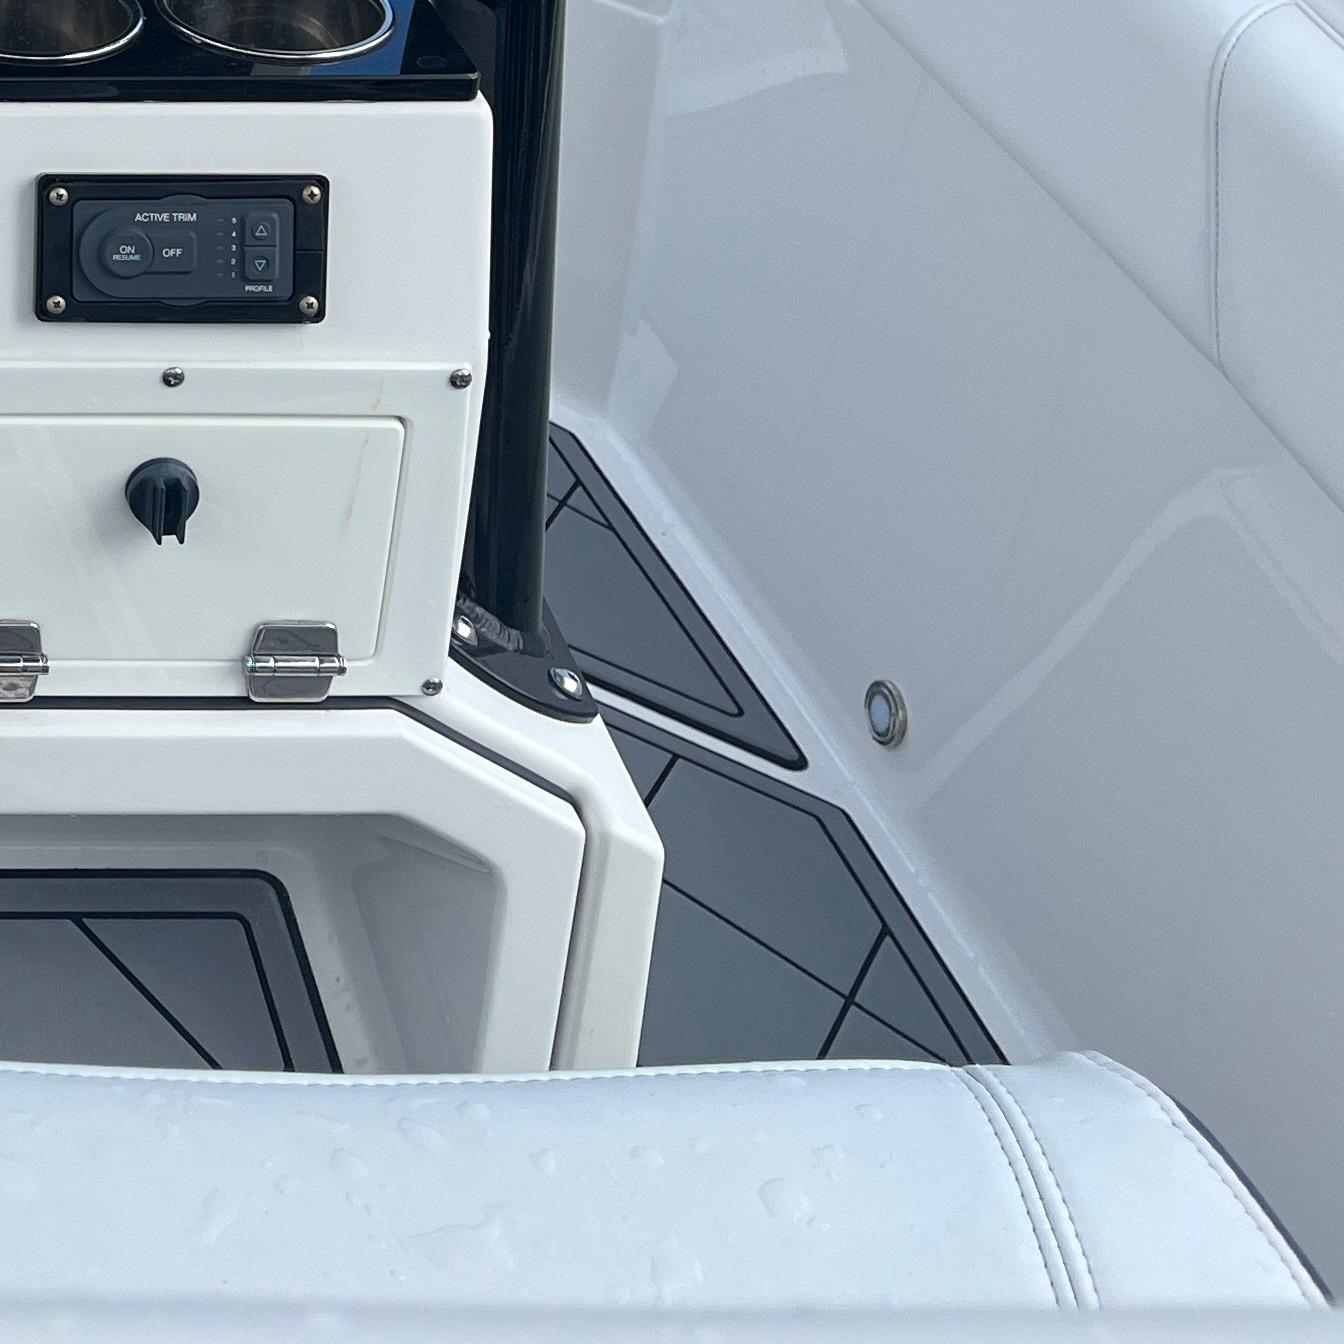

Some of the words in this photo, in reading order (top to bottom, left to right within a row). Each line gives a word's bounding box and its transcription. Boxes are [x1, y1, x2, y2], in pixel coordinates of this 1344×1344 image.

[134, 213, 170, 222] ACTIVE
[171, 213, 197, 222] TRIM
[119, 245, 135, 254] ON
[162, 249, 183, 257] OFF
